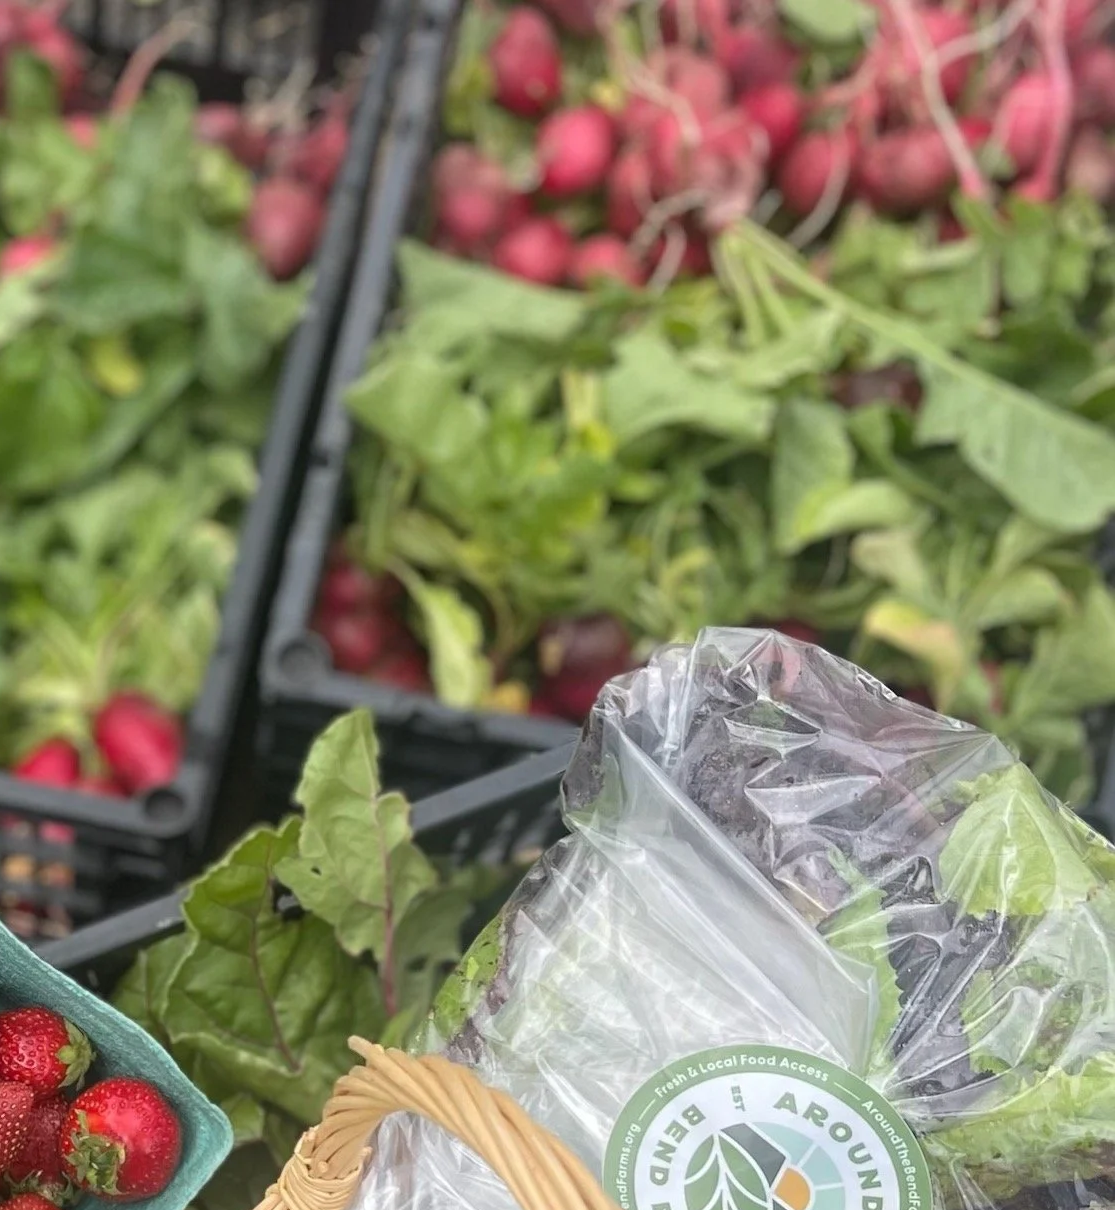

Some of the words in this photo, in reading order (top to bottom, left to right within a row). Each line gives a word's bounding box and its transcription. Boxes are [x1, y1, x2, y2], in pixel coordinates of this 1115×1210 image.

[655, 1070, 687, 1098] Fresh
[687, 1067, 698, 1078] &
[698, 1055, 738, 1073] Local
[741, 1054, 776, 1066] Food
[779, 1058, 829, 1082] Access
[731, 1085, 746, 1112] EST
[650, 1104, 706, 1186] BEND
